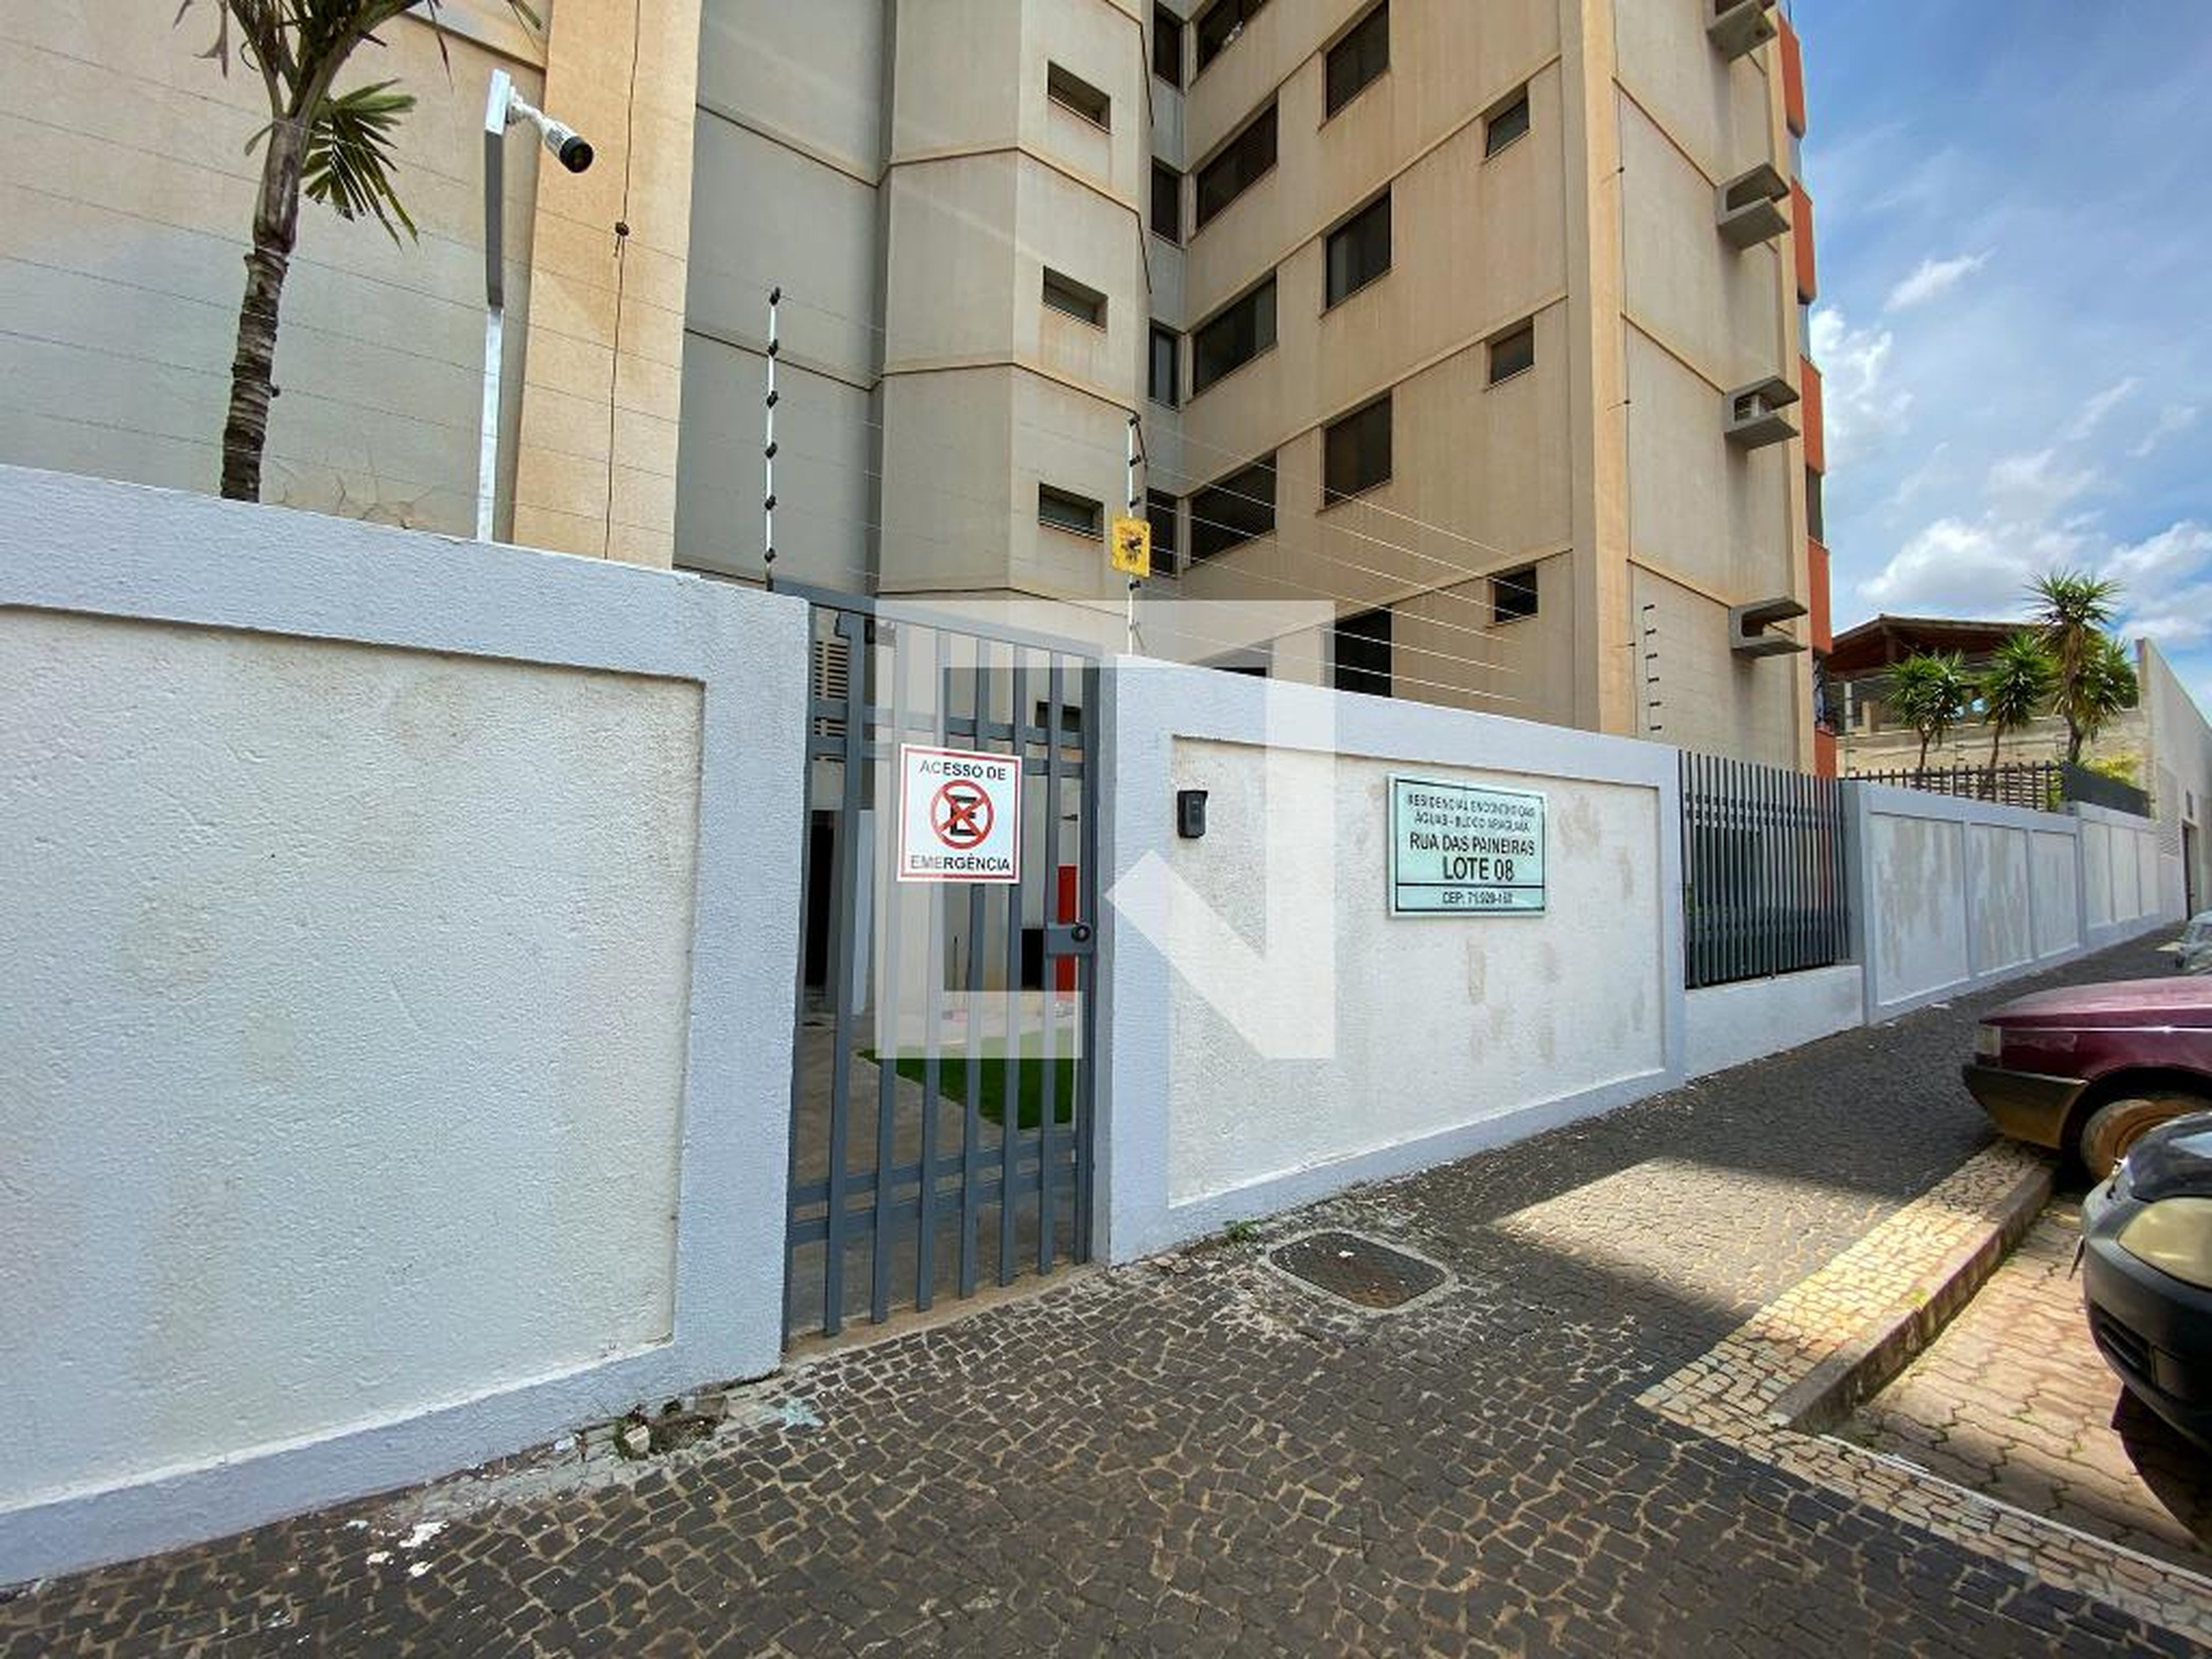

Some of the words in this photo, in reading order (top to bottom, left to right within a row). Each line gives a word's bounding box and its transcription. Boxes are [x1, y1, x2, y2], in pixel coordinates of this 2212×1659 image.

[919, 760, 983, 778] ACESSO
[987, 766, 1006, 781] DE
[1410, 832, 1439, 850] RUA
[1442, 835, 1469, 852] DAS
[1472, 836, 1535, 856] PAINEIRAS
[911, 853, 1010, 872] EMERGÊNCIA
[1443, 856, 1489, 880] LOTE
[1494, 858, 1515, 882] 08
[1442, 891, 1465, 904] CEP:
